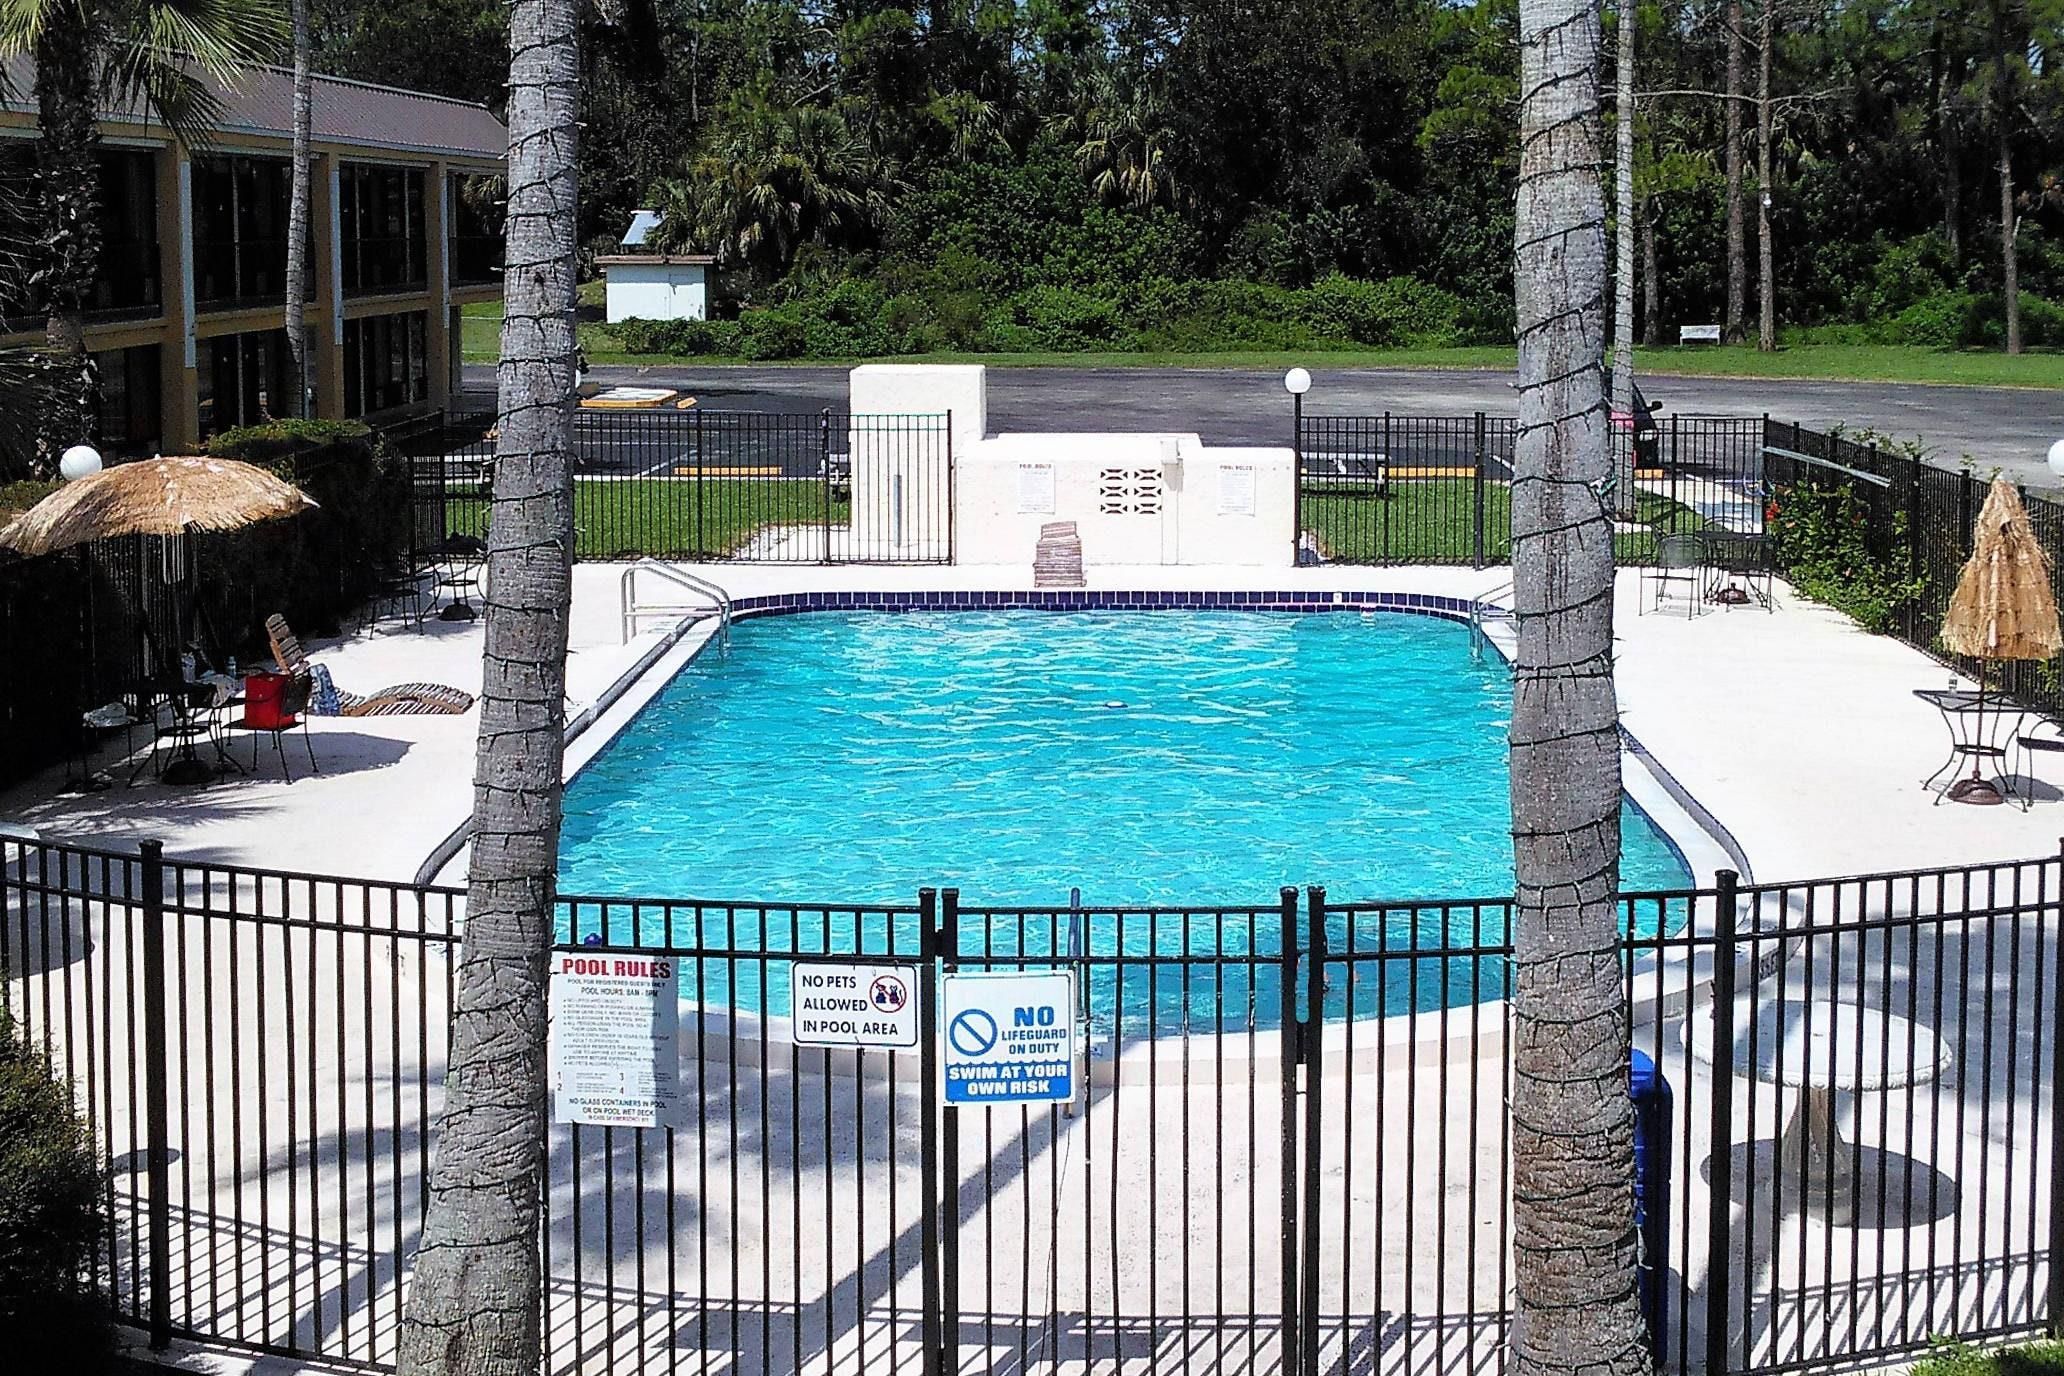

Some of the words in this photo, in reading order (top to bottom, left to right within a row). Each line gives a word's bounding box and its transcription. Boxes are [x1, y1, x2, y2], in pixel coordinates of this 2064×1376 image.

[562, 958, 610, 976] POOL
[614, 960, 671, 979] RULES
[802, 975, 823, 988] NO
[827, 976, 857, 989] PETS
[581, 987, 599, 995] POOL
[803, 998, 868, 1011] ALLOWED
[1014, 1006, 1055, 1027] NO
[803, 1020, 817, 1032] IN
[820, 1021, 858, 1034] POOL
[862, 1022, 898, 1035] AREA
[1001, 1028, 1067, 1041] LIFEGUARD
[1009, 1044, 1026, 1054] ON
[1029, 1043, 1059, 1054] DUTY
[948, 1066, 998, 1080] SWIM
[1000, 1065, 1022, 1079] AT
[1024, 1063, 1067, 1078] YOUR
[967, 1082, 1007, 1095] OWN
[1010, 1080, 1050, 1093] RISK
[580, 1098, 600, 1106] GLASS
[601, 1098, 641, 1107] CONTAINERS
[650, 1101, 667, 1109] POOL
